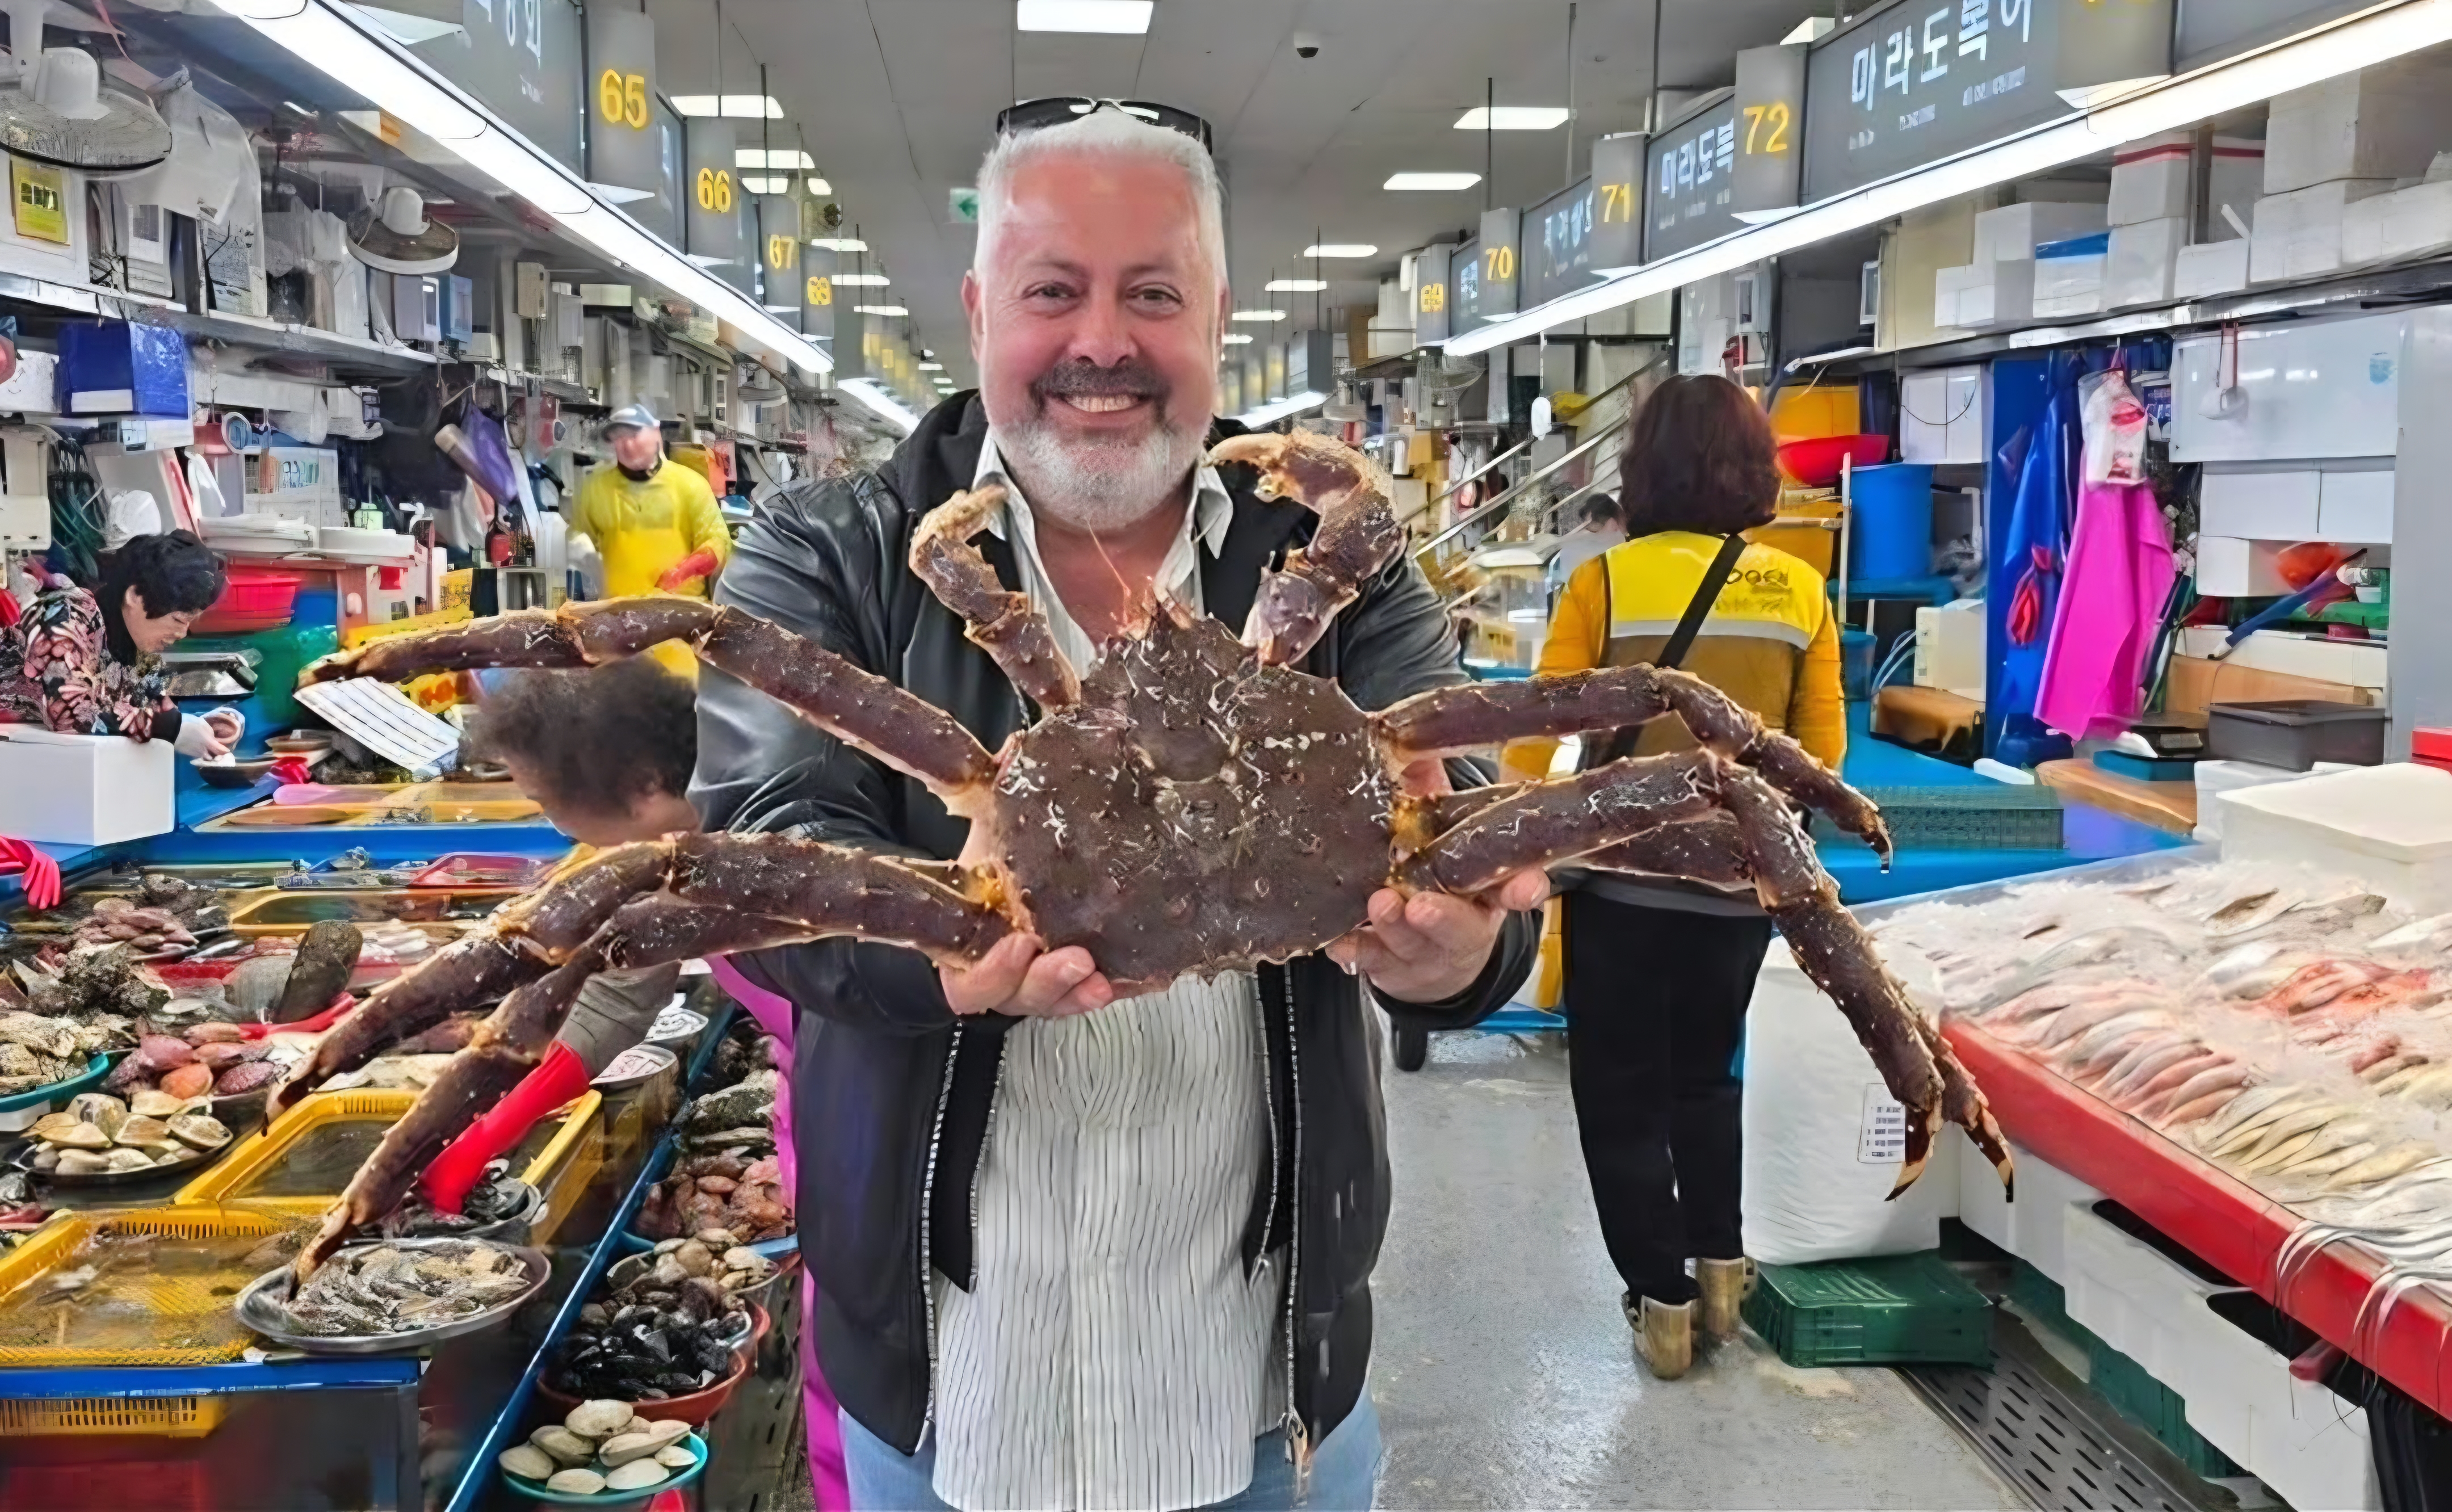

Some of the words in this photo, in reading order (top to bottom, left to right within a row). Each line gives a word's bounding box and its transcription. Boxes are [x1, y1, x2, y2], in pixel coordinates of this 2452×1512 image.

[600, 69, 647, 128] 65
[1743, 102, 1790, 154] 72
[697, 167, 731, 213] 66
[1602, 183, 1630, 222] 71
[770, 234, 795, 269] 67
[1485, 246, 1513, 280] 70
